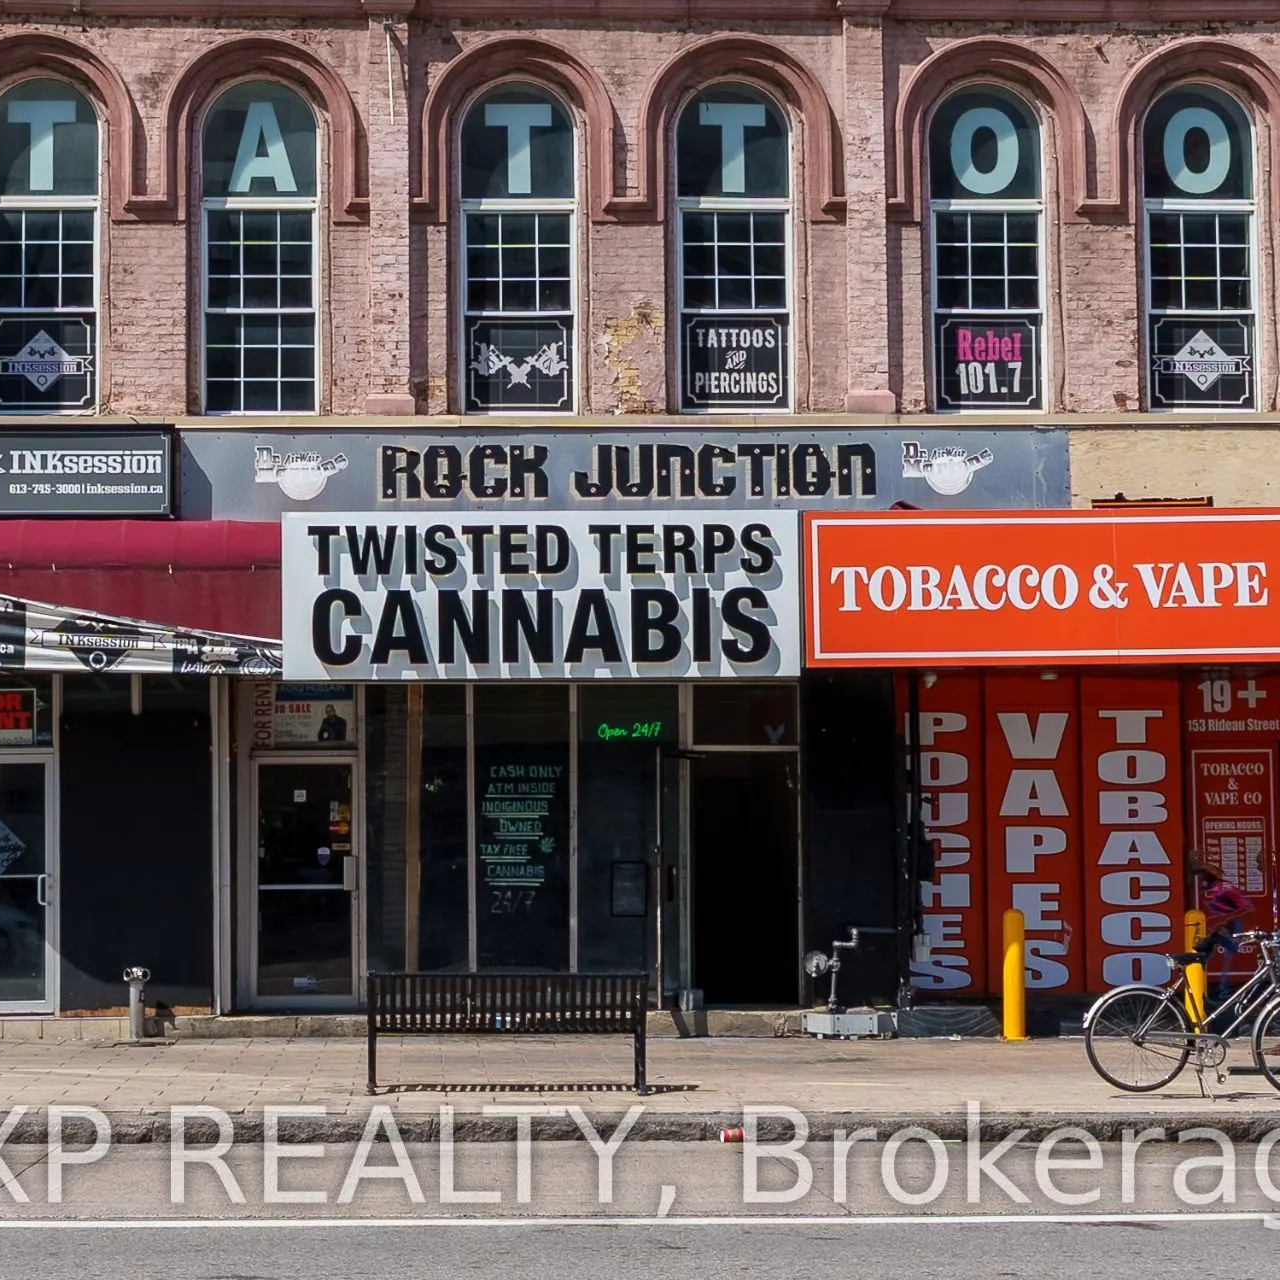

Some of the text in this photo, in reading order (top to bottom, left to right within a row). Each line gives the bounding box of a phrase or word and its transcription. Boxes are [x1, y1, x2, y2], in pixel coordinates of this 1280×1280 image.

[696, 328, 776, 348] TATTOOS
[957, 328, 1022, 361] Rebel
[8, 362, 78, 373] INKsession
[724, 350, 747, 369] AND
[1170, 361, 1236, 372] INKsession
[695, 372, 778, 394] PIERCINGS
[955, 362, 1022, 394] 101.7
[9, 449, 164, 475] INKsession
[380, 444, 549, 499] ROCK
[574, 443, 876, 498] JUNCTION
[307, 523, 775, 577] TWISTED TERPS
[830, 564, 1079, 612] TOBACCO
[1091, 564, 1128, 610] &
[1133, 561, 1269, 609] VAPE
[312, 587, 772, 666] CANNABIS
[58, 634, 139, 649] INKsession
[274, 704, 312, 714] OR SALE
[254, 719, 273, 748] FOR
[598, 722, 662, 740] Open 24/7
[1187, 718, 1280, 732] 153 Rideau Street
[490, 765, 563, 778] CASH ONLY
[1200, 763, 1264, 776] TOBACCO
[487, 782, 557, 794] ATM INSIDE
[1227, 777, 1239, 790] &
[1204, 792, 1263, 805] VAPE CO
[499, 818, 543, 832] OWNED
[1205, 821, 1235, 830] OPENING
[480, 844, 499, 855] TAX
[904, 712, 972, 989] POUCHES
[996, 712, 1070, 989] VAPES
[1097, 710, 1172, 987] TOBACCO
[487, 865, 545, 877] CANNABIS
[490, 890, 536, 914] 24/7
